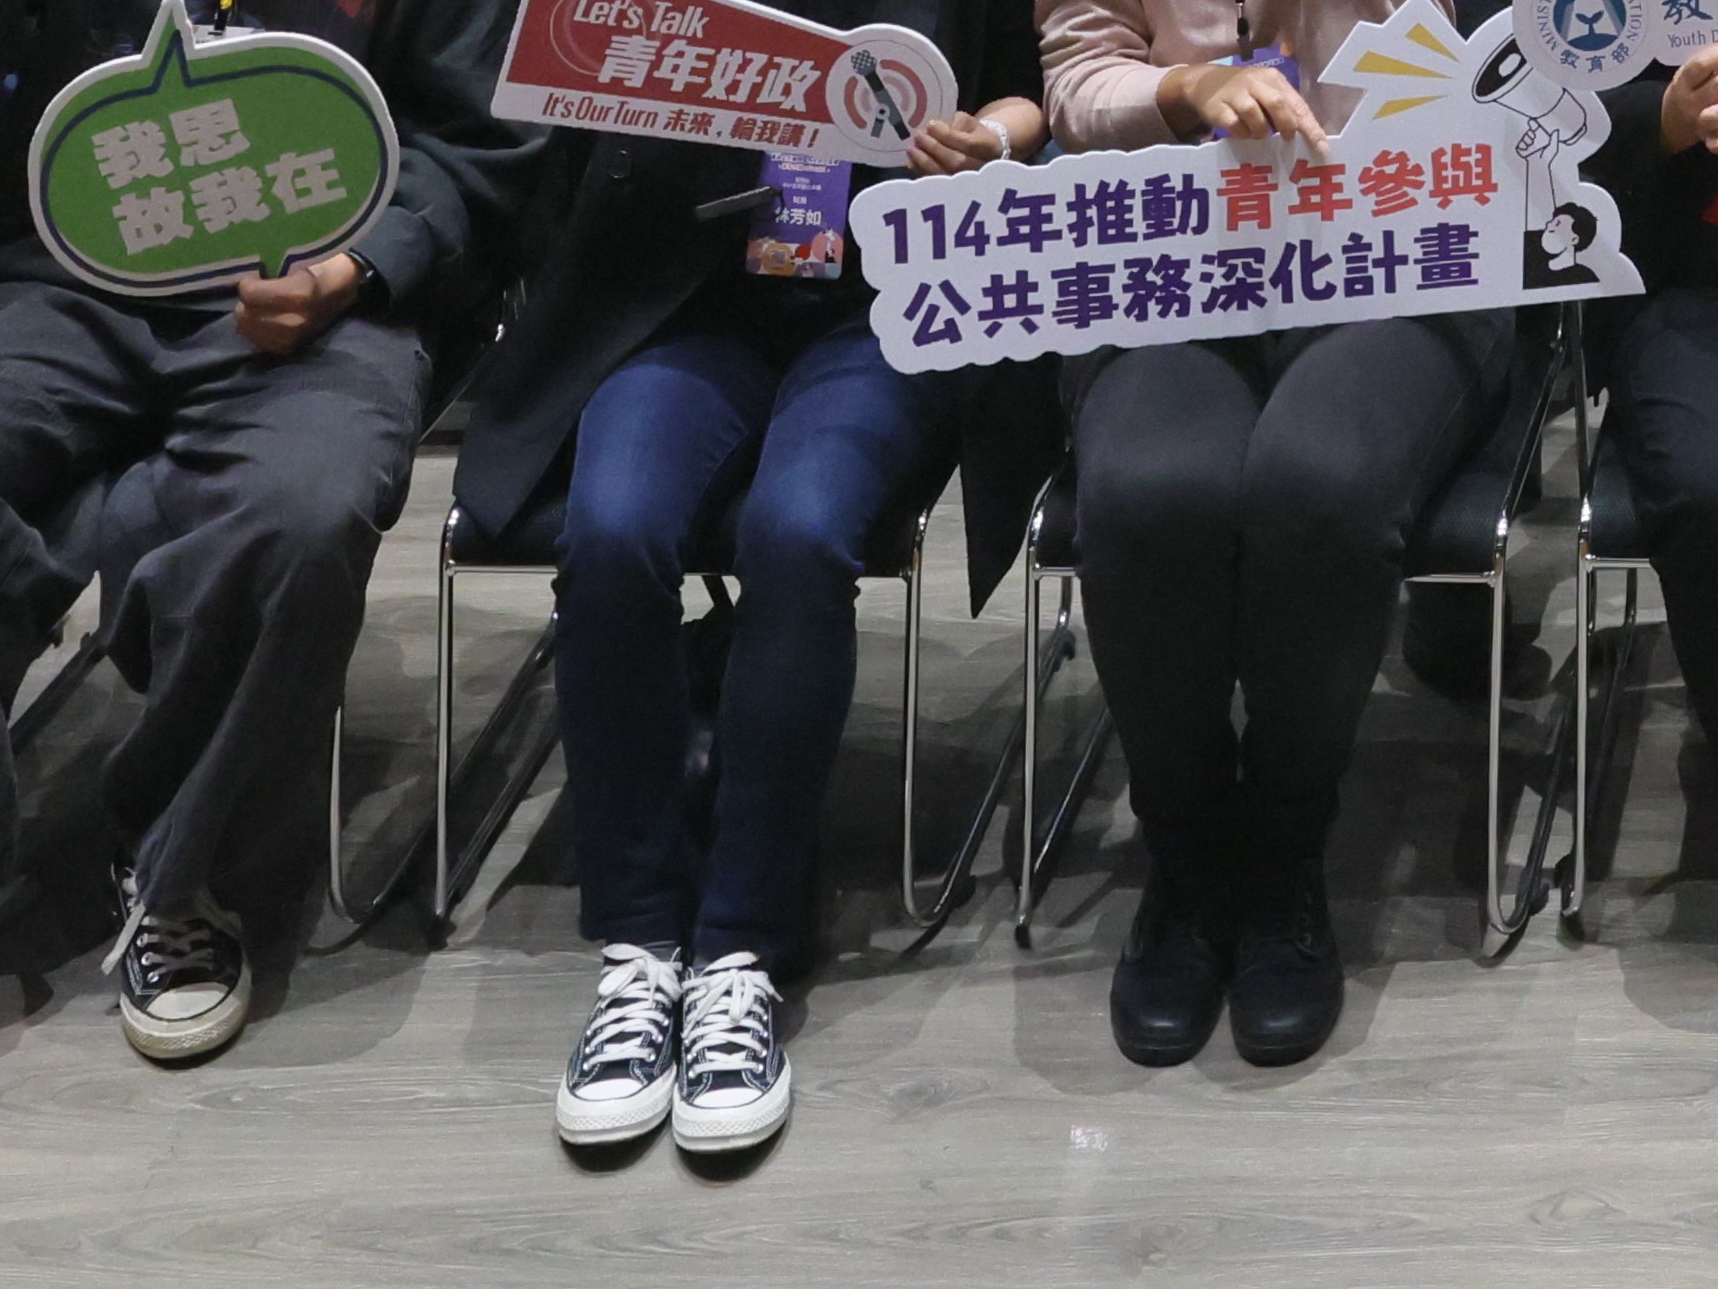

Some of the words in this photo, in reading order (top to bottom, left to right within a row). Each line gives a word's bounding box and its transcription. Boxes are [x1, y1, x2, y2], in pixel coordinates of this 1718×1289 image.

[650, 0, 711, 37] Talk
[1559, 42, 1632, 73] 教育部
[1666, 25, 1709, 51] Youth
[599, 34, 821, 111] 青年好政
[91, 96, 251, 190] 我思
[111, 147, 349, 257] 故我在
[882, 145, 1500, 266] 114年推動青年參與
[903, 220, 1481, 346] 公共事務深化計畫
